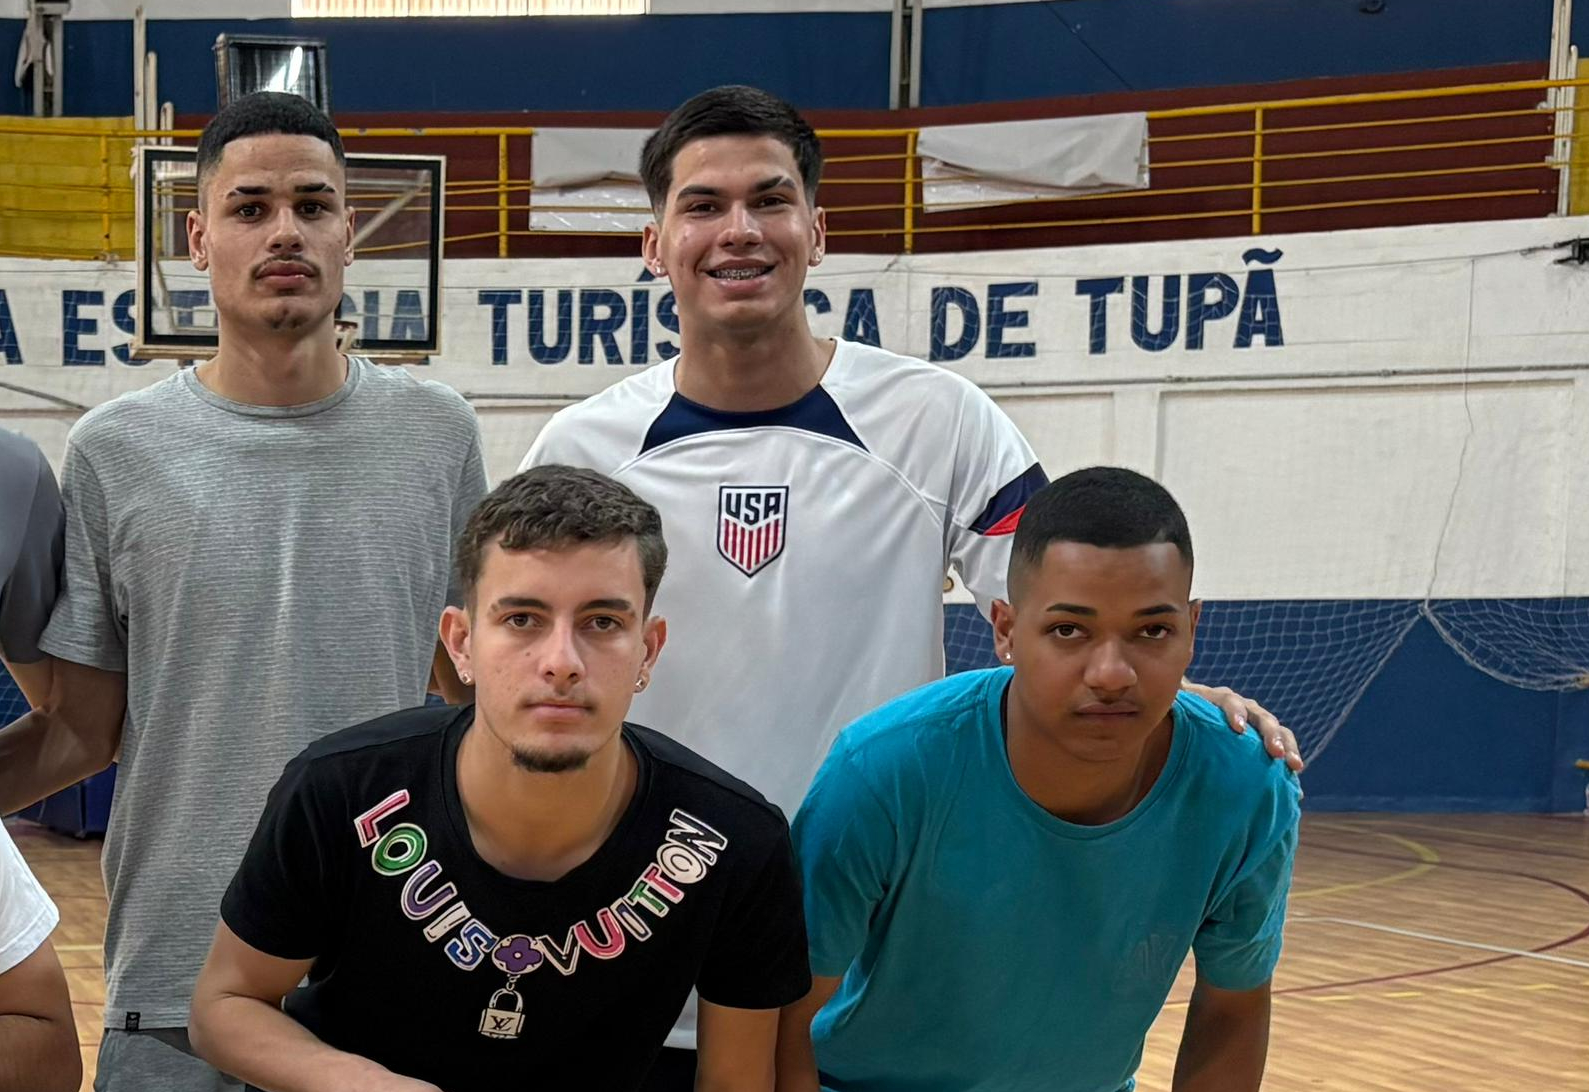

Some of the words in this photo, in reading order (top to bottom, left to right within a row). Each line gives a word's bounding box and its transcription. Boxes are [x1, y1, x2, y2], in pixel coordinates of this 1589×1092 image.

[928, 281, 1039, 363] DE
[1075, 248, 1285, 355] TUPÃ
[725, 492, 782, 526] USA
[353, 788, 500, 971] LOUIS
[536, 808, 728, 976] VUITTON
